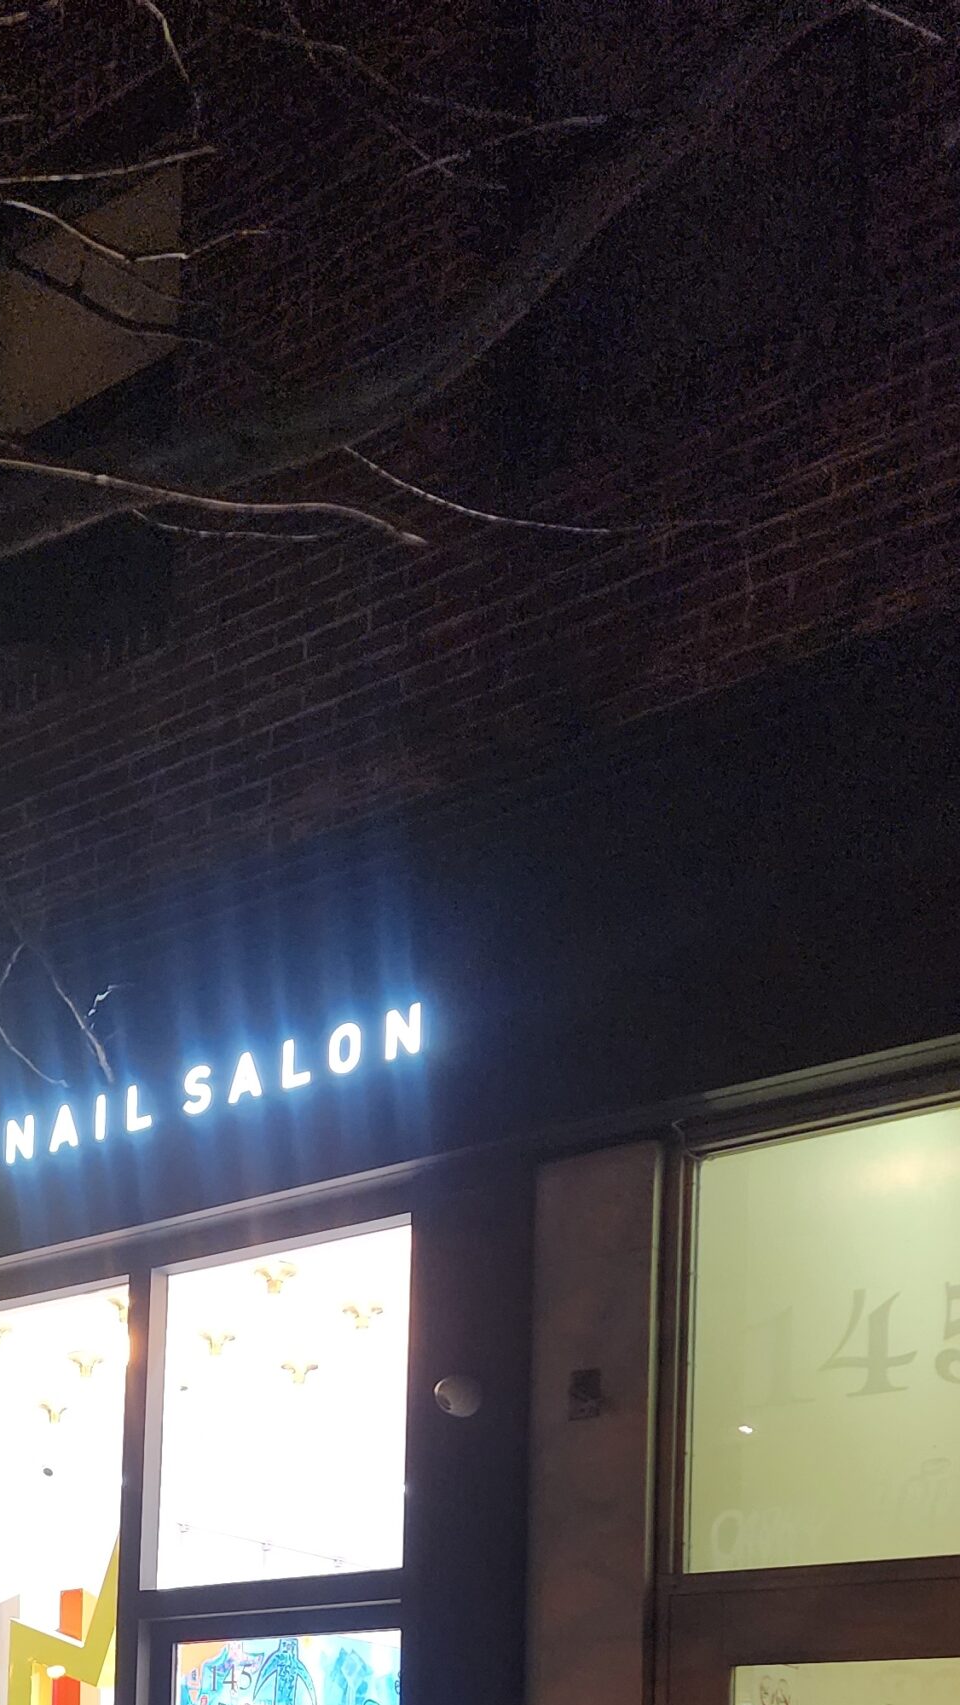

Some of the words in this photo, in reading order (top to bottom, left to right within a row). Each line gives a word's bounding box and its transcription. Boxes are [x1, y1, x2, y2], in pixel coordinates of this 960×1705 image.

[4, 1083, 154, 1165] NAIL
[182, 1002, 424, 1117] SALON
[209, 1663, 253, 1692] 145
